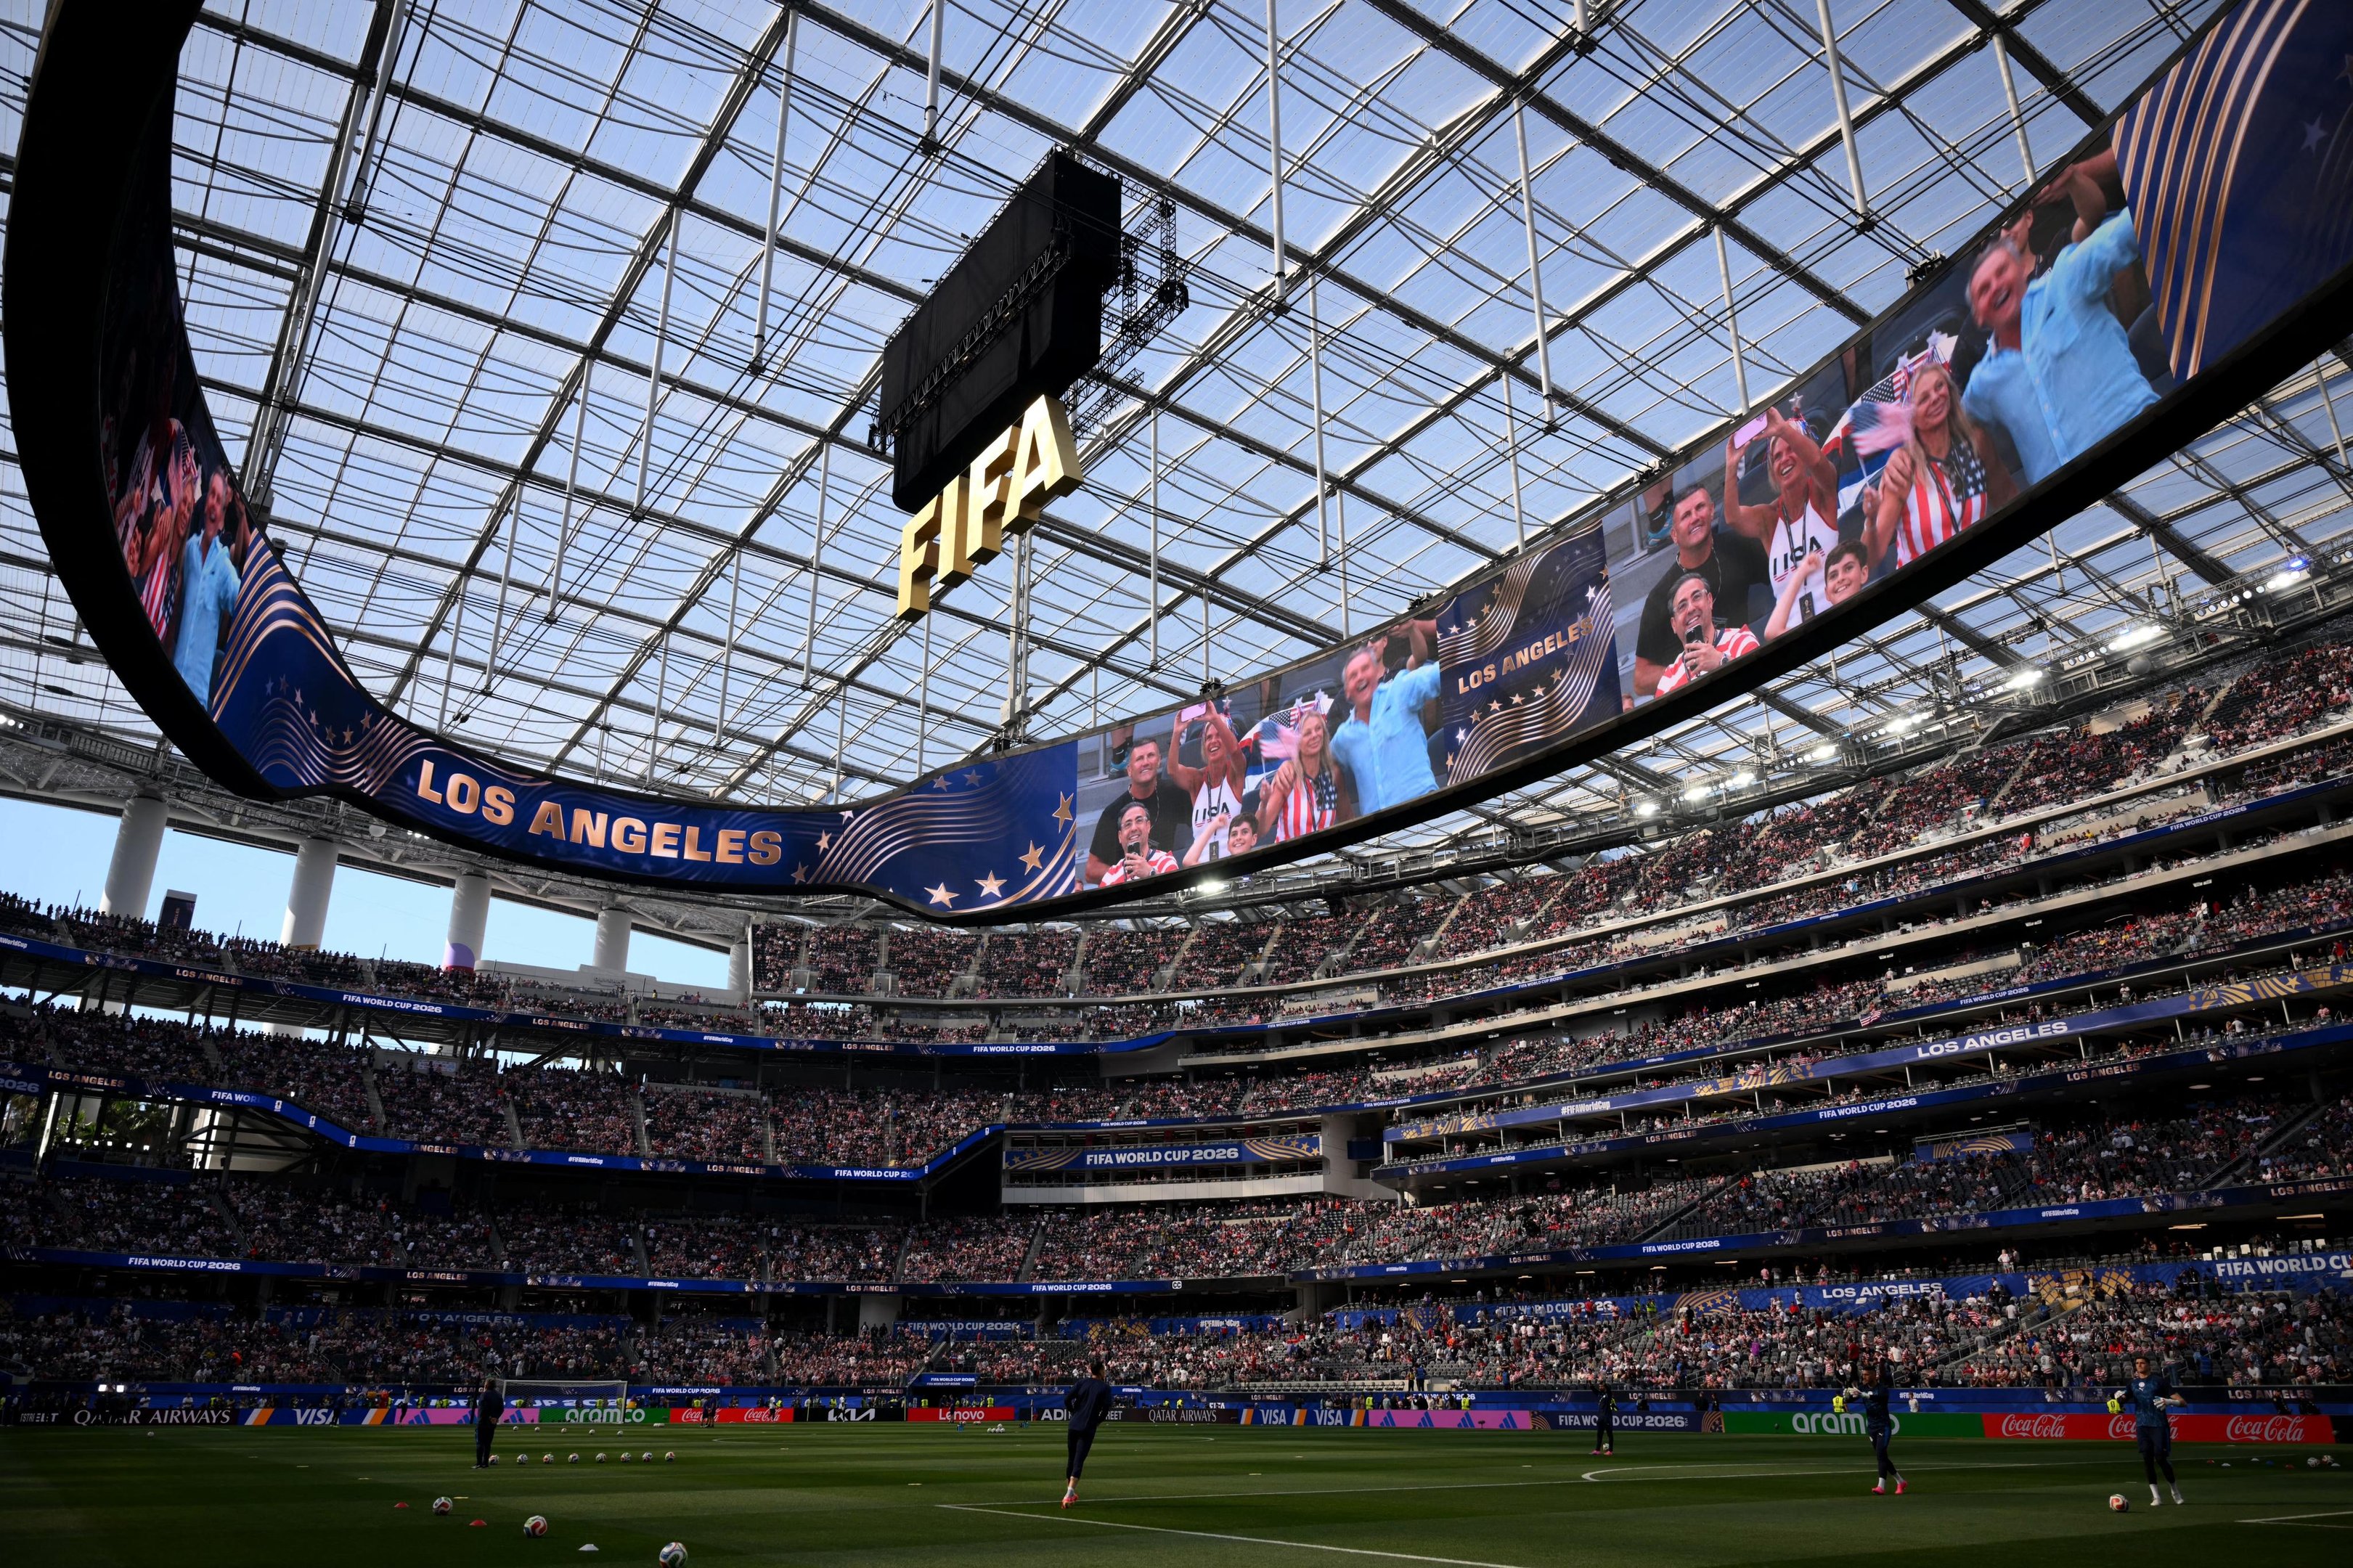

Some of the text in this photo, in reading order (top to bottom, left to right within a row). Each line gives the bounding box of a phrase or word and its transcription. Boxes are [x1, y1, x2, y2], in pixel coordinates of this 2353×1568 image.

[897, 394, 1084, 622] FIFA
[1774, 536, 1824, 581] USA
[1458, 616, 1594, 695] LOS ANGELES
[417, 759, 782, 866] LOS ANGELES
[1194, 802, 1231, 827] USA
[2185, 817, 2208, 828] WORLD
[2223, 806, 2247, 817] 2026
[176, 969, 244, 986] LOS ANGELES
[1973, 993, 1994, 1002] WORLD
[2007, 987, 2029, 996] 2026
[343, 995, 443, 1013] FIFA WORLD CUP 2026
[551, 1021, 590, 1029] ANGELES
[1917, 1021, 2068, 1058] LOS ANGELES
[48, 1071, 126, 1087] LOS ANGELES
[2067, 1063, 2141, 1082] LOS ANGELES
[211, 1090, 232, 1101] FIFA
[1561, 1101, 1611, 1115] #FIFAWorldCup
[1819, 1098, 1917, 1119] FIFA WORLD CUP 2026
[1646, 1130, 1697, 1143] LOS ANGELES
[412, 1144, 458, 1154] ANGELES
[1086, 1148, 1239, 1165] FIFA WORLD CUP 2026
[726, 1166, 767, 1175] ANGELES
[2270, 1180, 2353, 1196] LOS ANGELES
[1845, 1226, 1883, 1235] ANGELES
[1695, 1240, 1720, 1249] 2026
[128, 1257, 150, 1266] FIFA
[151, 1259, 187, 1268] WORLD
[208, 1262, 241, 1270] 2026
[1522, 1254, 1551, 1262] ANGELES
[2216, 1260, 2256, 1276] FIFA
[2258, 1256, 2325, 1273] WORLD
[426, 1272, 468, 1281] ANGELES
[1822, 1287, 1856, 1299] LOS
[2228, 1389, 2252, 1400] LOS
[149, 1409, 232, 1424] AIRWAYS
[1149, 1409, 1217, 1423] QATAR AIRWAYS
[1259, 1409, 1286, 1424] VISA
[1313, 1409, 1343, 1426] VISA
[1558, 1415, 1581, 1426] FIFA
[1622, 1415, 1643, 1427] CUP
[2002, 1413, 2067, 1437] Coca-Cola
[2226, 1416, 2306, 1442] Coca-Cola
